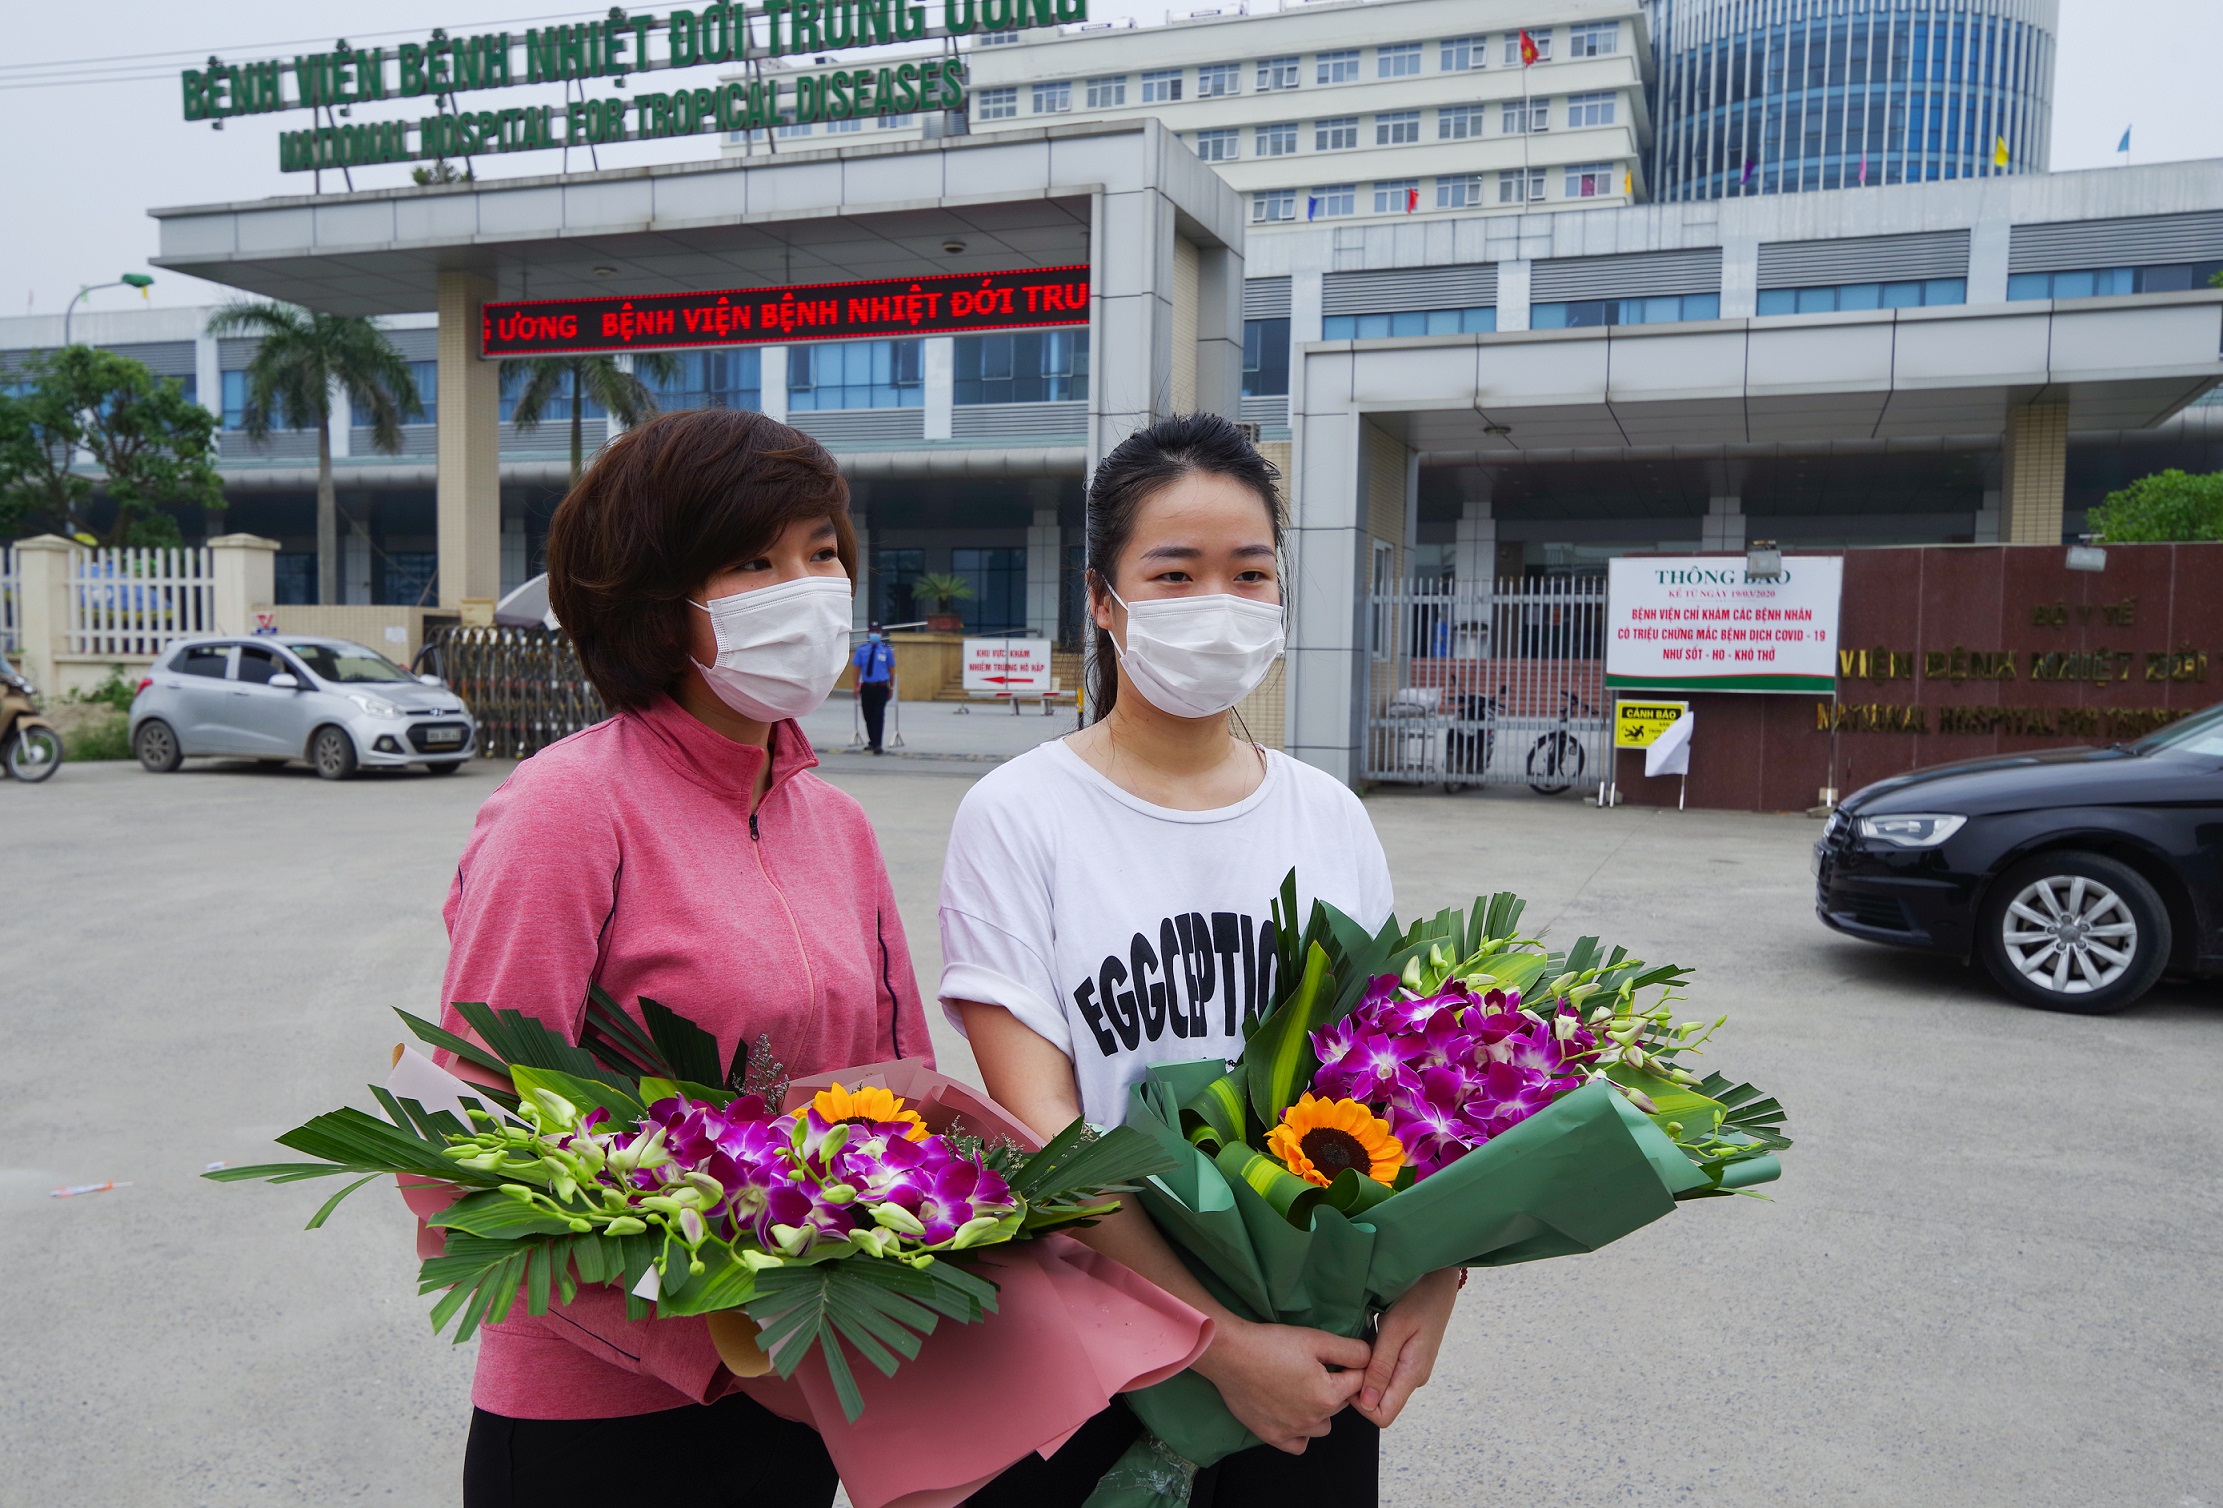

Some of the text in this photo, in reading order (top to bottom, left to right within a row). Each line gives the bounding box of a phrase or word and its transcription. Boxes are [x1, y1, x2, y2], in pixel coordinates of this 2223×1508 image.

[182, 56, 282, 130] BỆNH
[294, 38, 383, 117] VIỆN
[399, 28, 511, 108] BỆNH
[526, 6, 653, 88] NHIỆT
[763, 0, 926, 56] TRUNG
[280, 58, 963, 172] NATIONAL HOSPITAL FOR TROPICAL DISEASES
[499, 311, 577, 341] ƯƠNG
[602, 302, 674, 341] BỆNH
[683, 297, 750, 337] VIỆN
[761, 292, 838, 333] BỆNH
[847, 283, 943, 326] NHIỆT
[950, 278, 1014, 317] ĐỚI
[1655, 565, 1735, 585] THÔNG
[1632, 606, 1657, 622] BỆNH
[1660, 606, 1681, 623] VIỆN
[1755, 606, 1781, 623] BỆNH
[1633, 626, 1659, 642] TRIỆU
[1721, 627, 1747, 643] BỆNH
[1750, 630, 1772, 643] DỊCH
[1775, 630, 1803, 641] COVID
[1814, 630, 1826, 641] 19
[1663, 648, 1683, 660] NHƯ
[1712, 649, 1725, 660] HO
[1839, 645, 1914, 687] VIỆN
